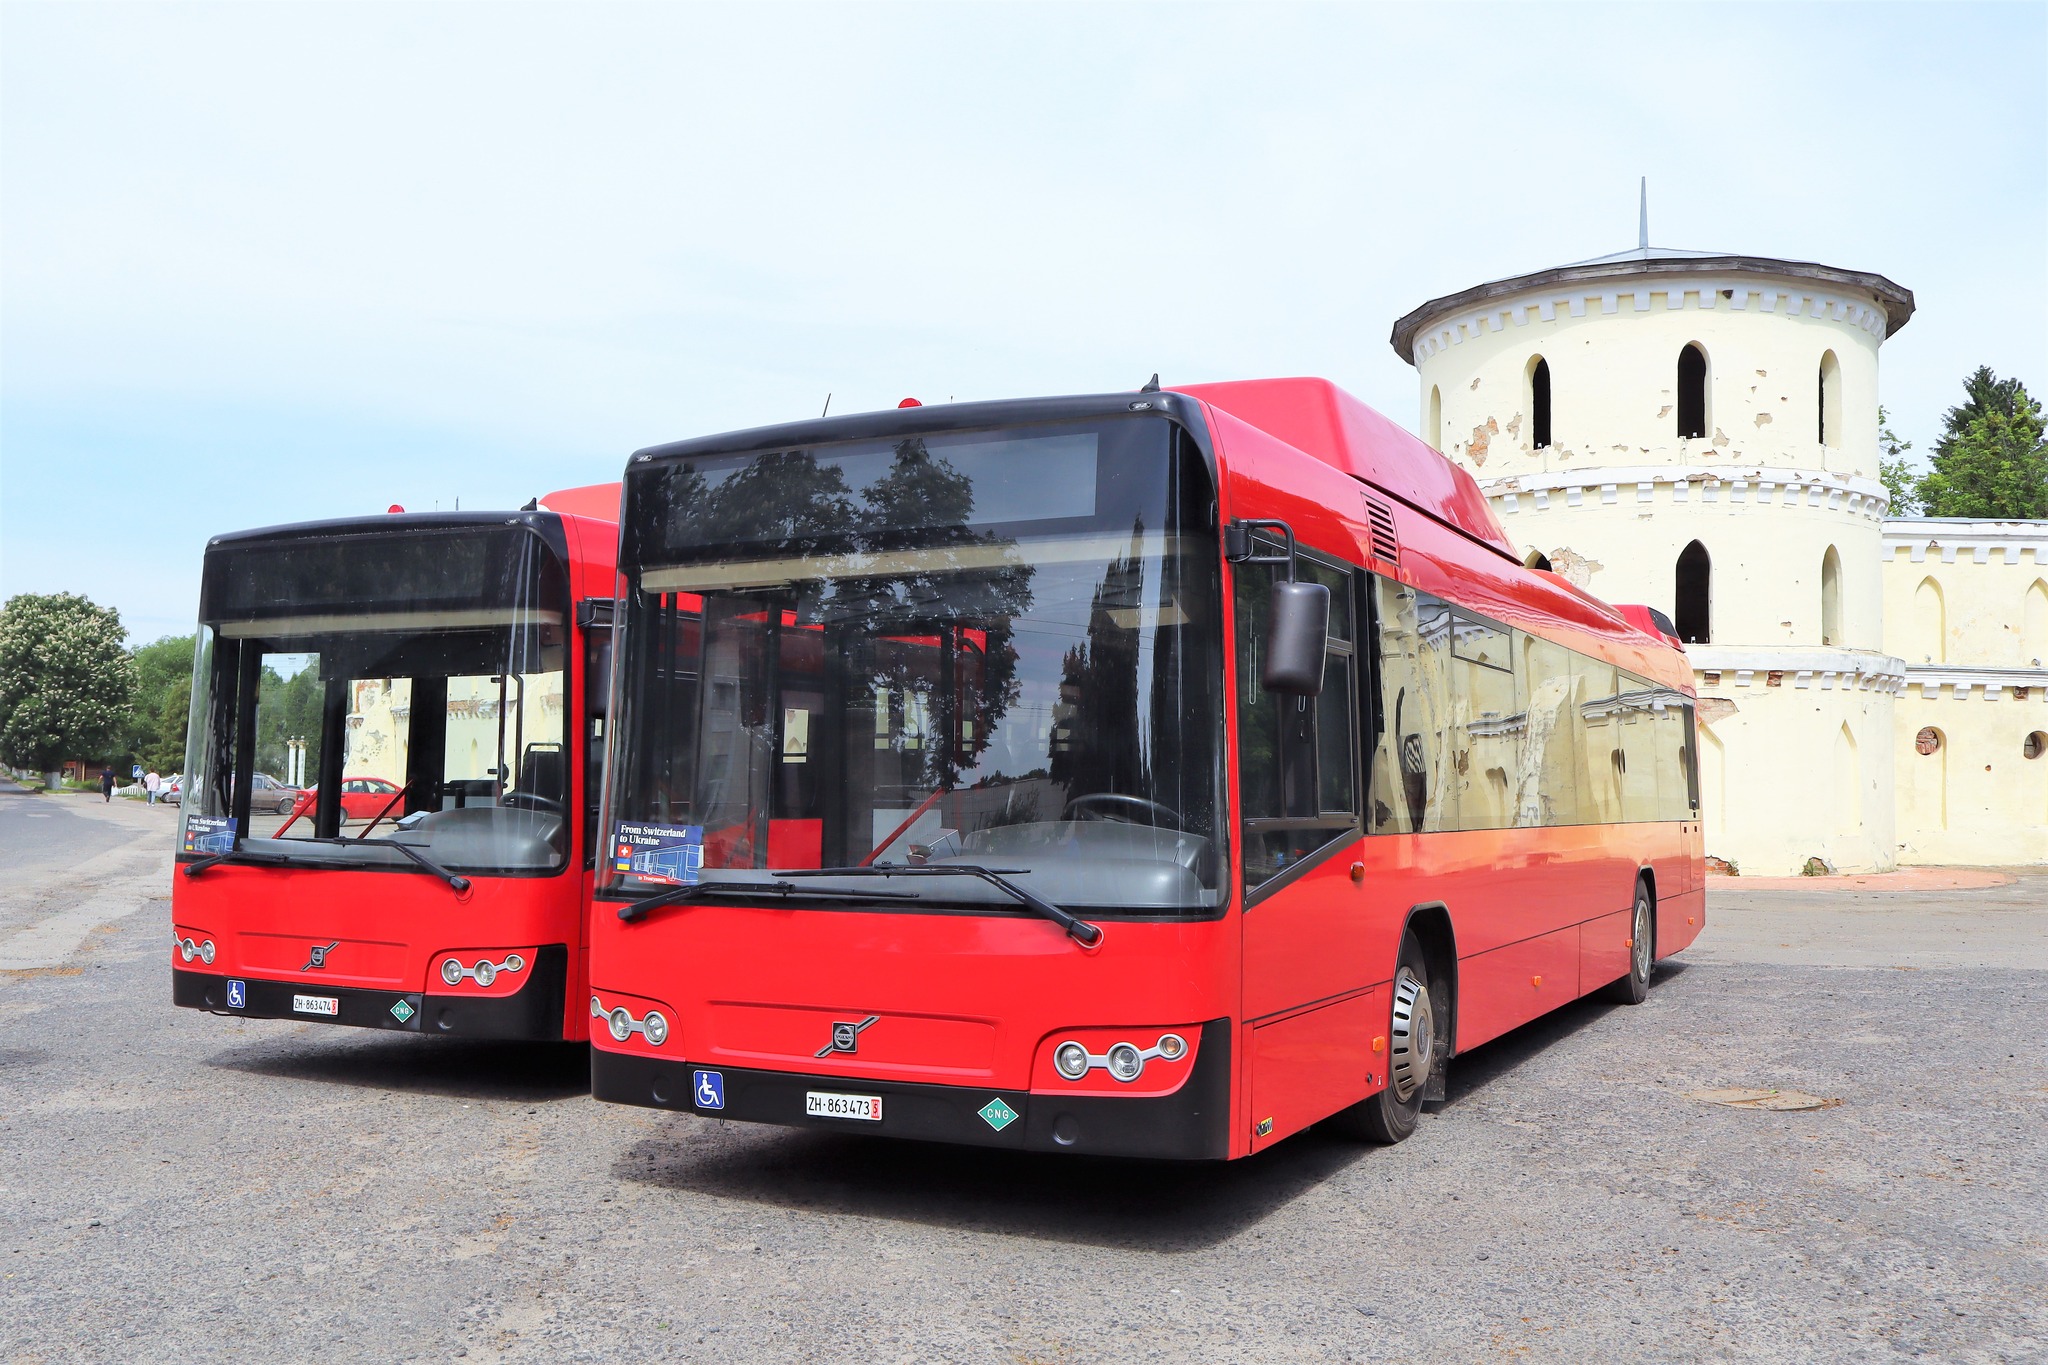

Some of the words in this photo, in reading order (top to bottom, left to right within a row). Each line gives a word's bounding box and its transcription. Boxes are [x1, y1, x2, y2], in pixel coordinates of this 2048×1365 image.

[620, 824, 642, 835] From
[642, 826, 687, 838] Switzerland
[619, 834, 628, 843] to
[629, 835, 660, 846] Ukraine
[395, 1007, 409, 1015] CNG
[987, 1108, 1009, 1120] CNG
